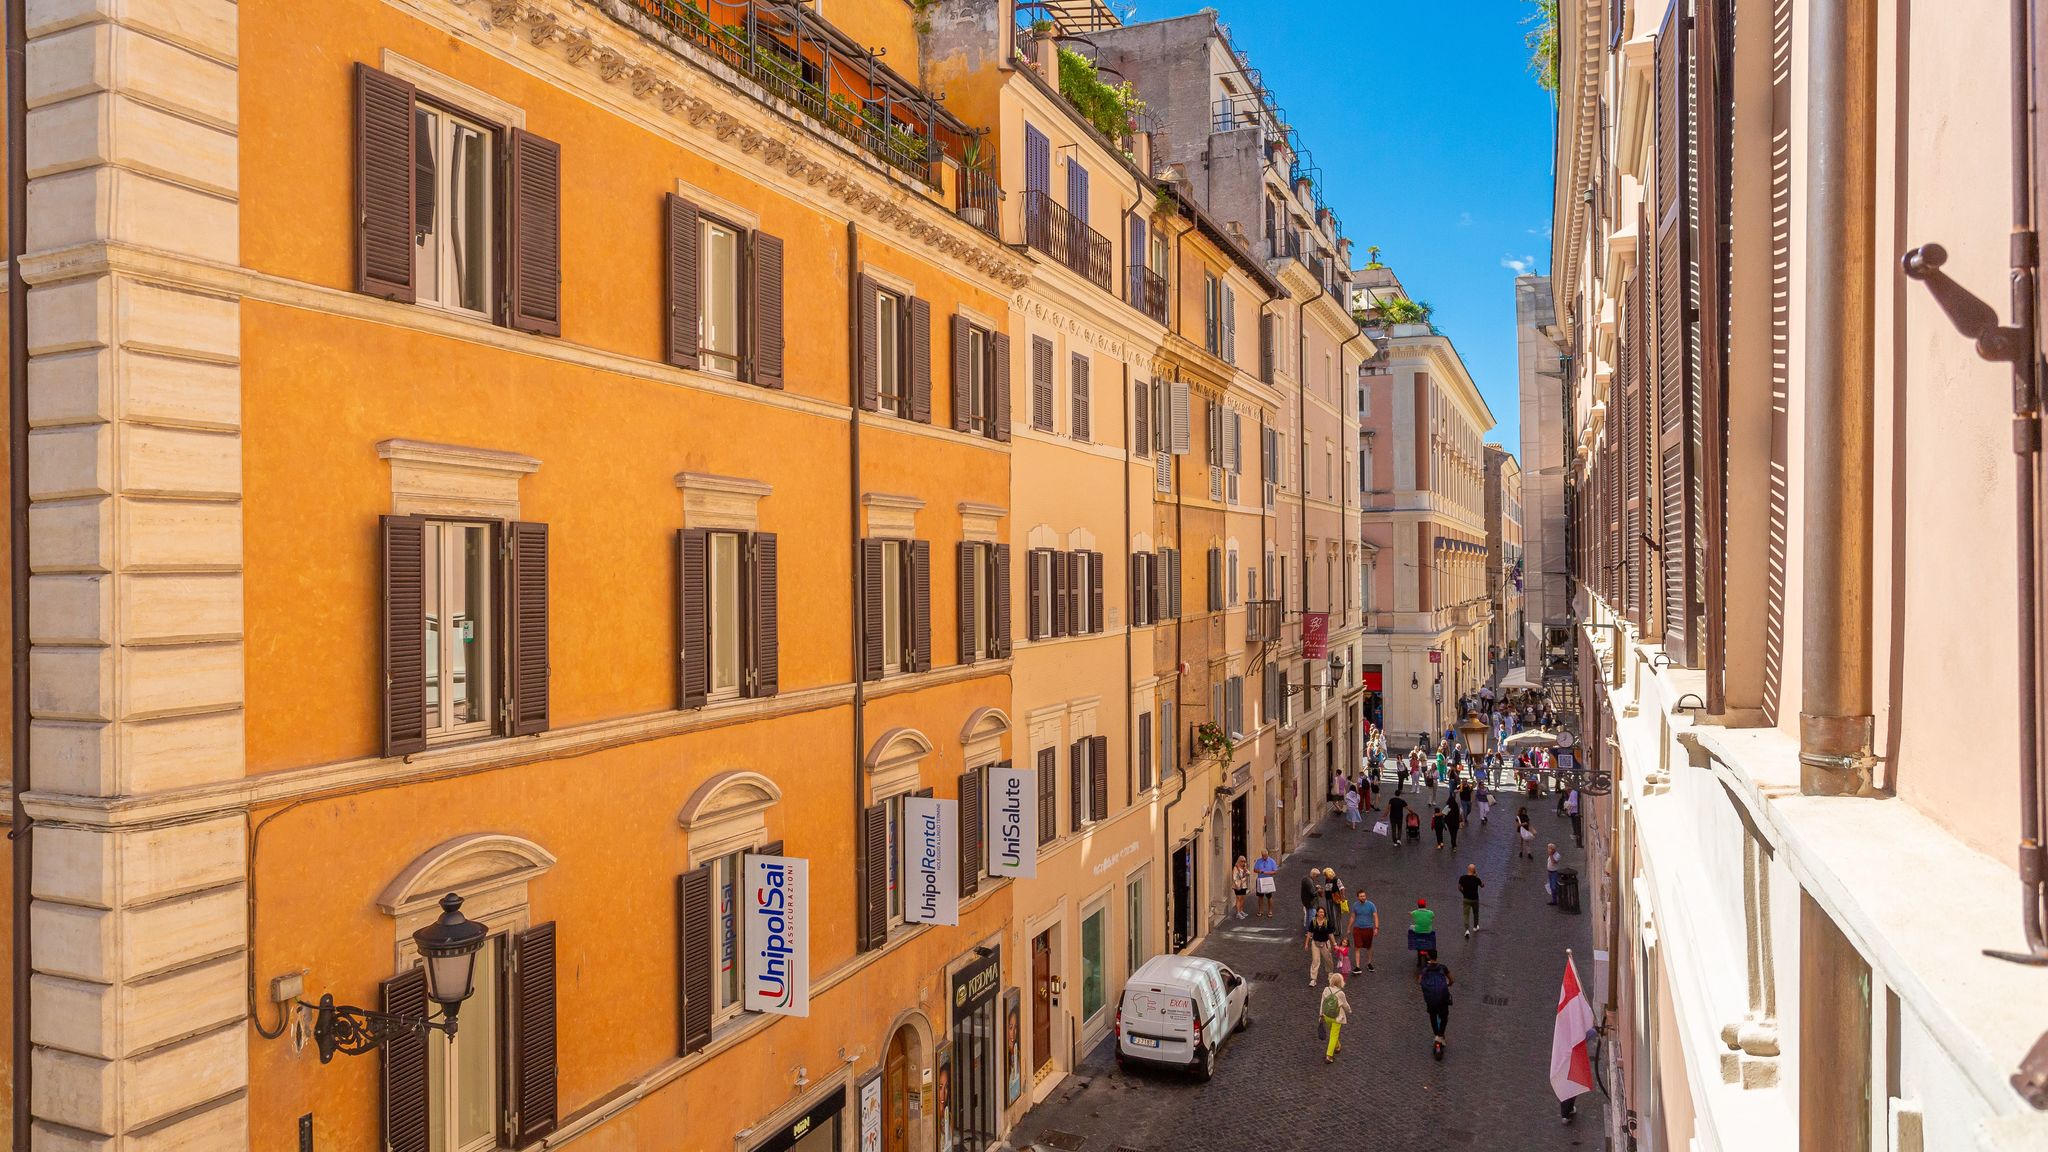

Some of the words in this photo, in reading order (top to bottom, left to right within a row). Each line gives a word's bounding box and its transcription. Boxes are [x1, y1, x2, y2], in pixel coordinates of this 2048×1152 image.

[921, 815, 940, 919] UnipolRental
[1002, 778, 1020, 867] UniSalute
[721, 884, 736, 973] UnipolSai
[758, 863, 793, 998] UnipolSai
[968, 962, 998, 997] KEDMA
